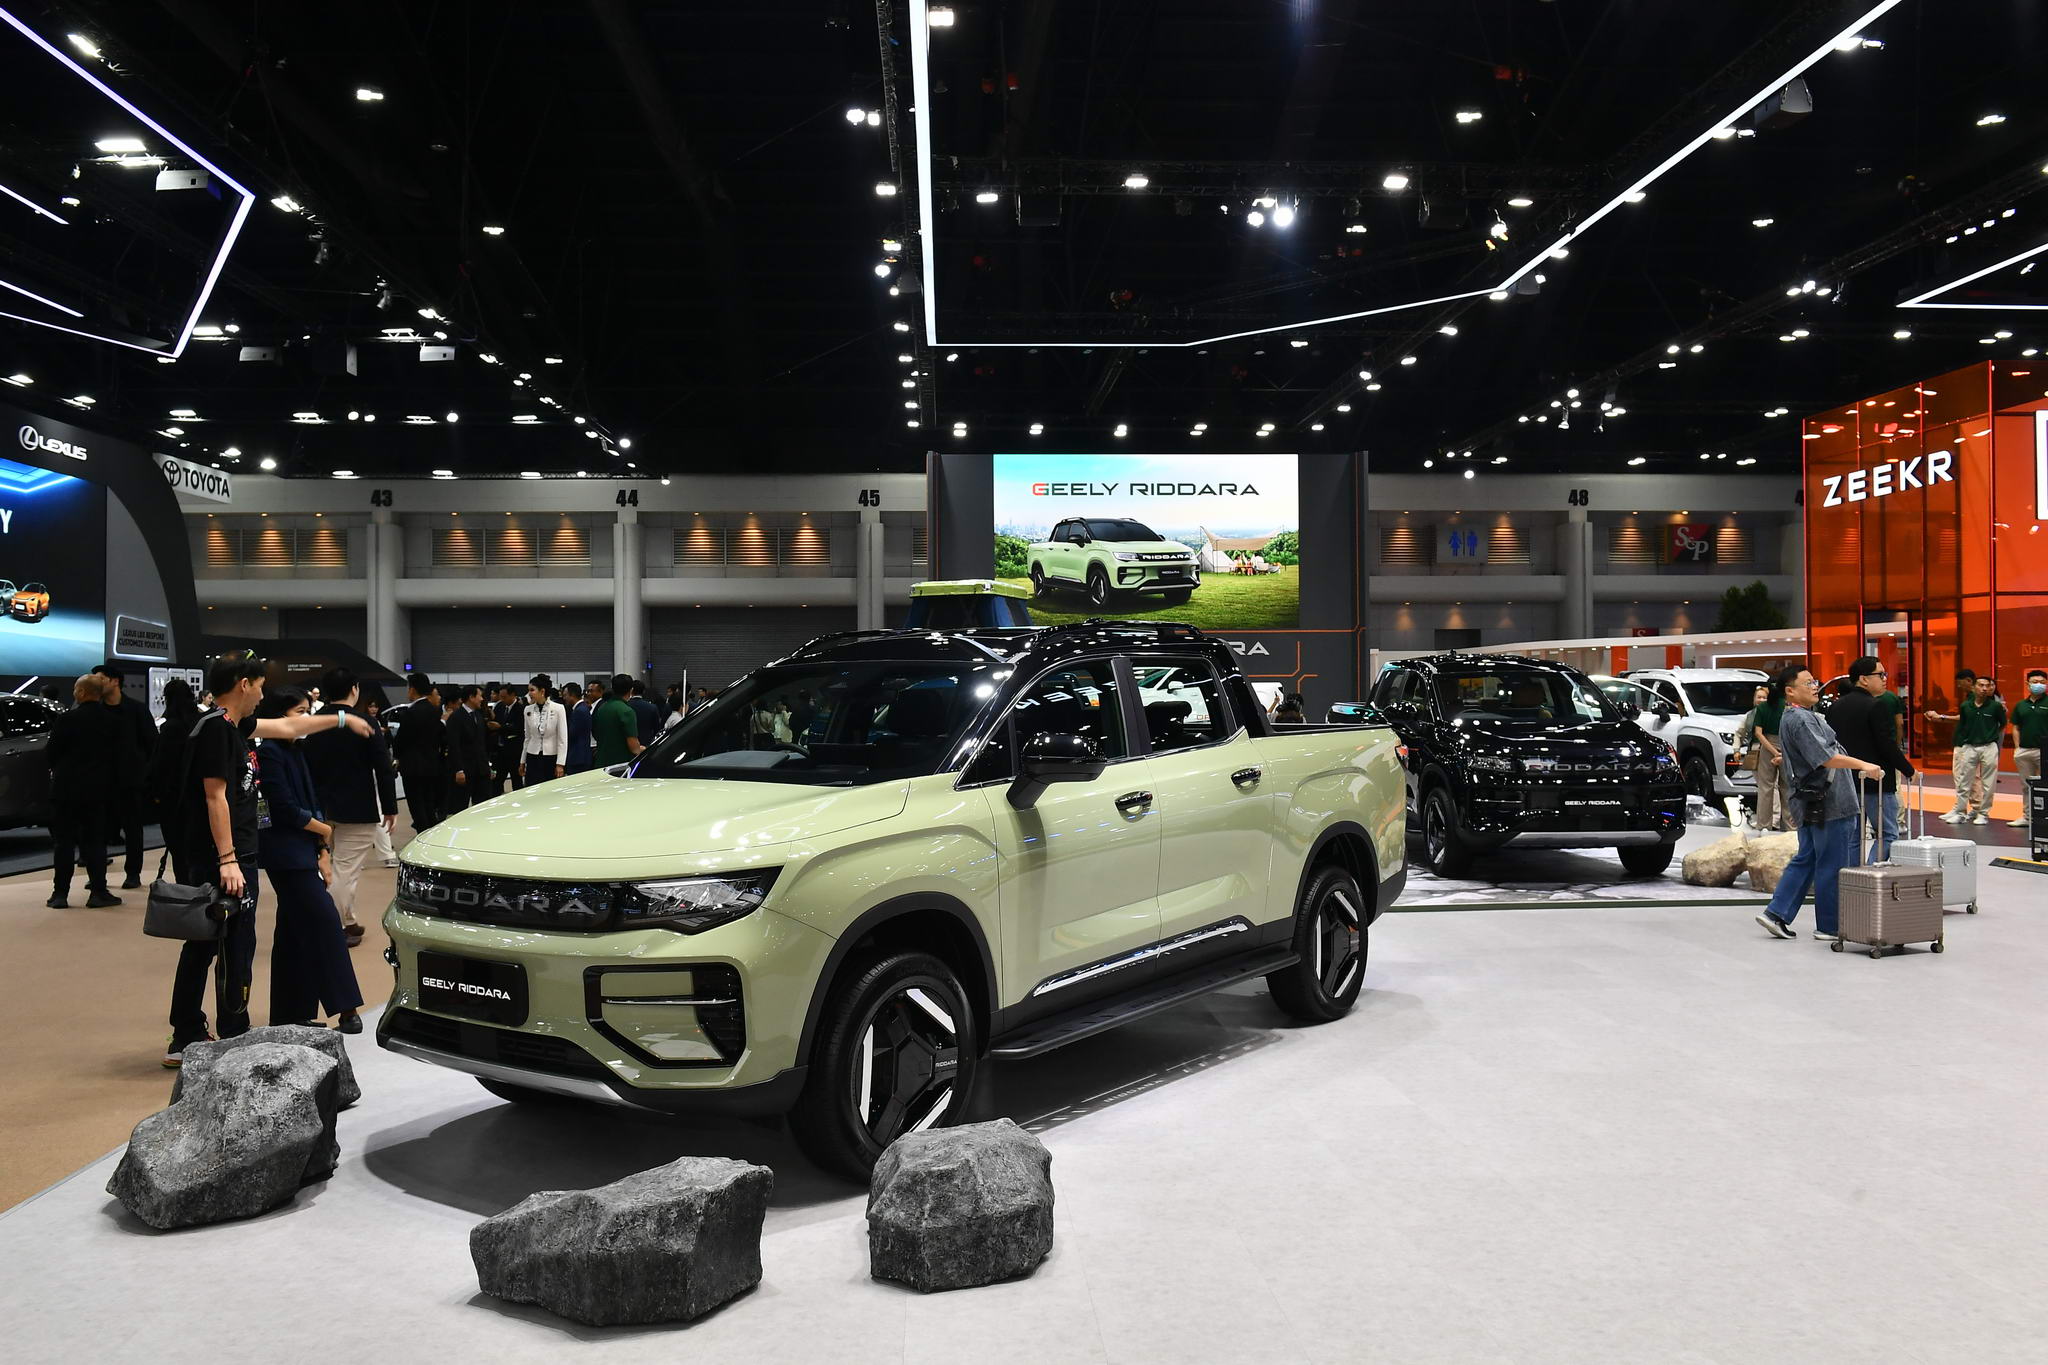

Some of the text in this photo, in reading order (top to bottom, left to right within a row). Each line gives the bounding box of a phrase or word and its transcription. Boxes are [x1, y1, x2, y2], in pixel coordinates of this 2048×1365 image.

[38, 434, 88, 461] LEXUS
[183, 467, 230, 498] TOYOTA
[1823, 450, 1953, 507] ZEEKR
[370, 489, 393, 507] 43
[616, 489, 638, 507] 44
[858, 489, 880, 507] 45
[1032, 483, 1260, 496] GEELY RIDDARA
[1568, 489, 1589, 506] 48
[422, 976, 511, 1001] GEELY RIDDARA
